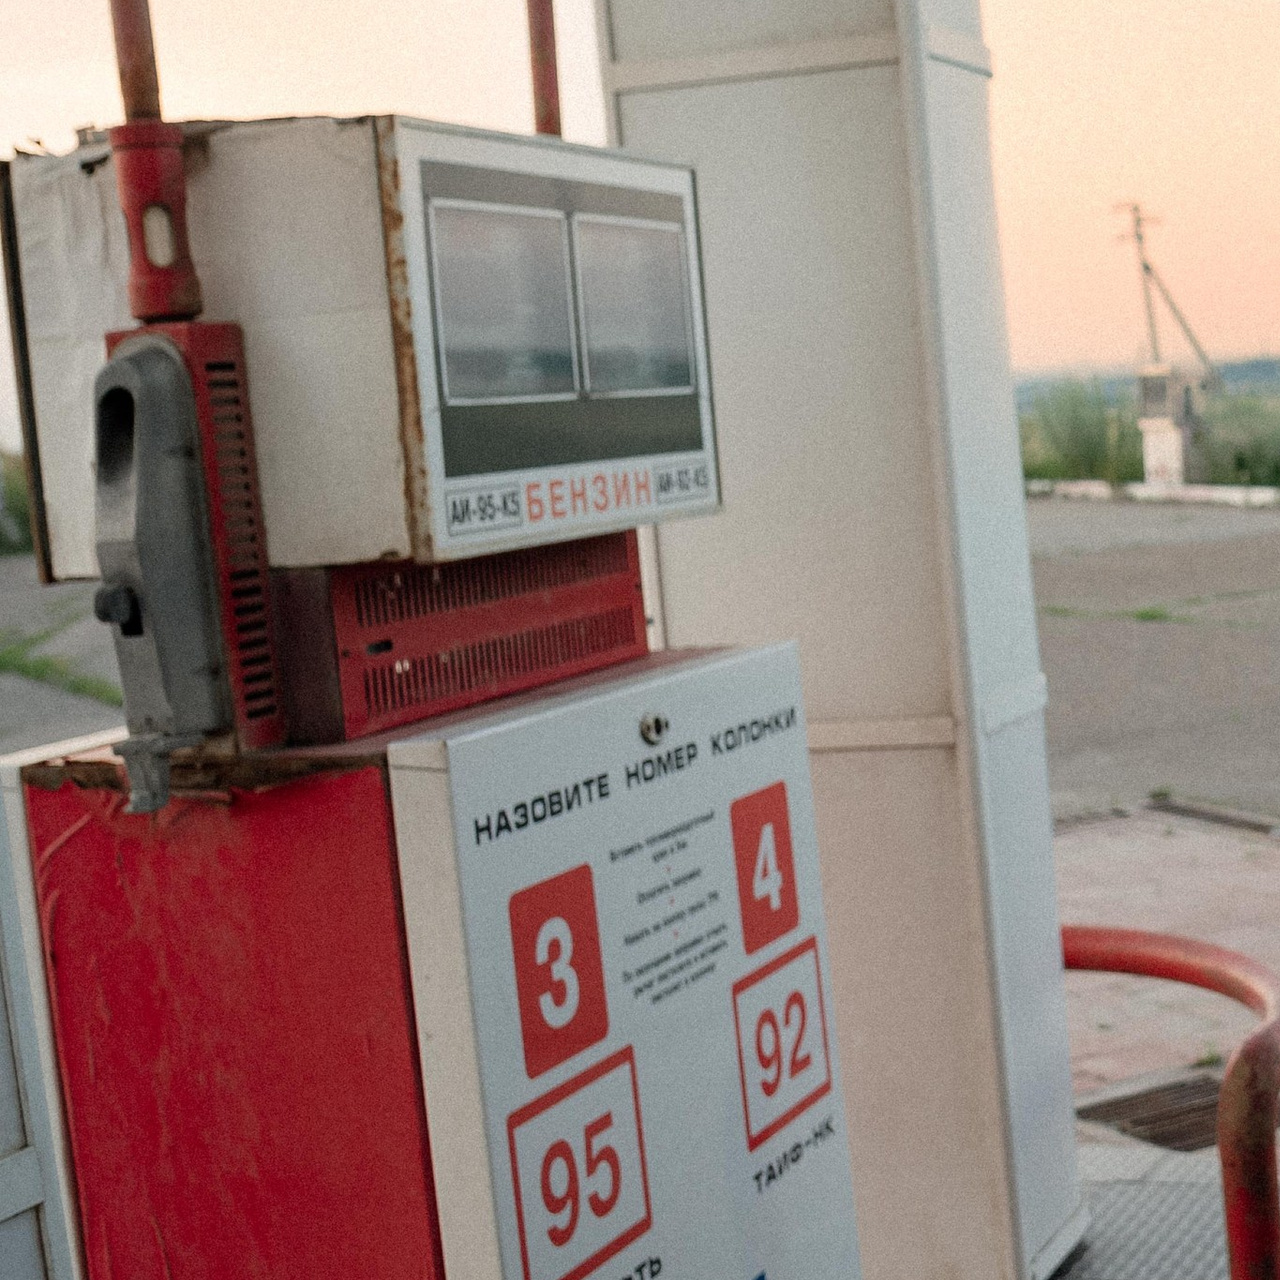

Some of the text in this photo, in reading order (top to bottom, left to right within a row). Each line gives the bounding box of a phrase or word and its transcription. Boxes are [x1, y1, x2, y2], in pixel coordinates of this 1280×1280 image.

[525, 469, 652, 523] БЕНЗИН
[474, 773, 611, 845] НАЗОВИТЕ
[625, 742, 700, 790] НОМЕР
[711, 706, 798, 757] КОЛОНКИ
[752, 821, 783, 912] 4
[534, 915, 581, 1029] 3
[754, 991, 812, 1098] 92
[540, 1110, 622, 1248] 95
[752, 1117, 837, 1194] ТАИФ-НК
